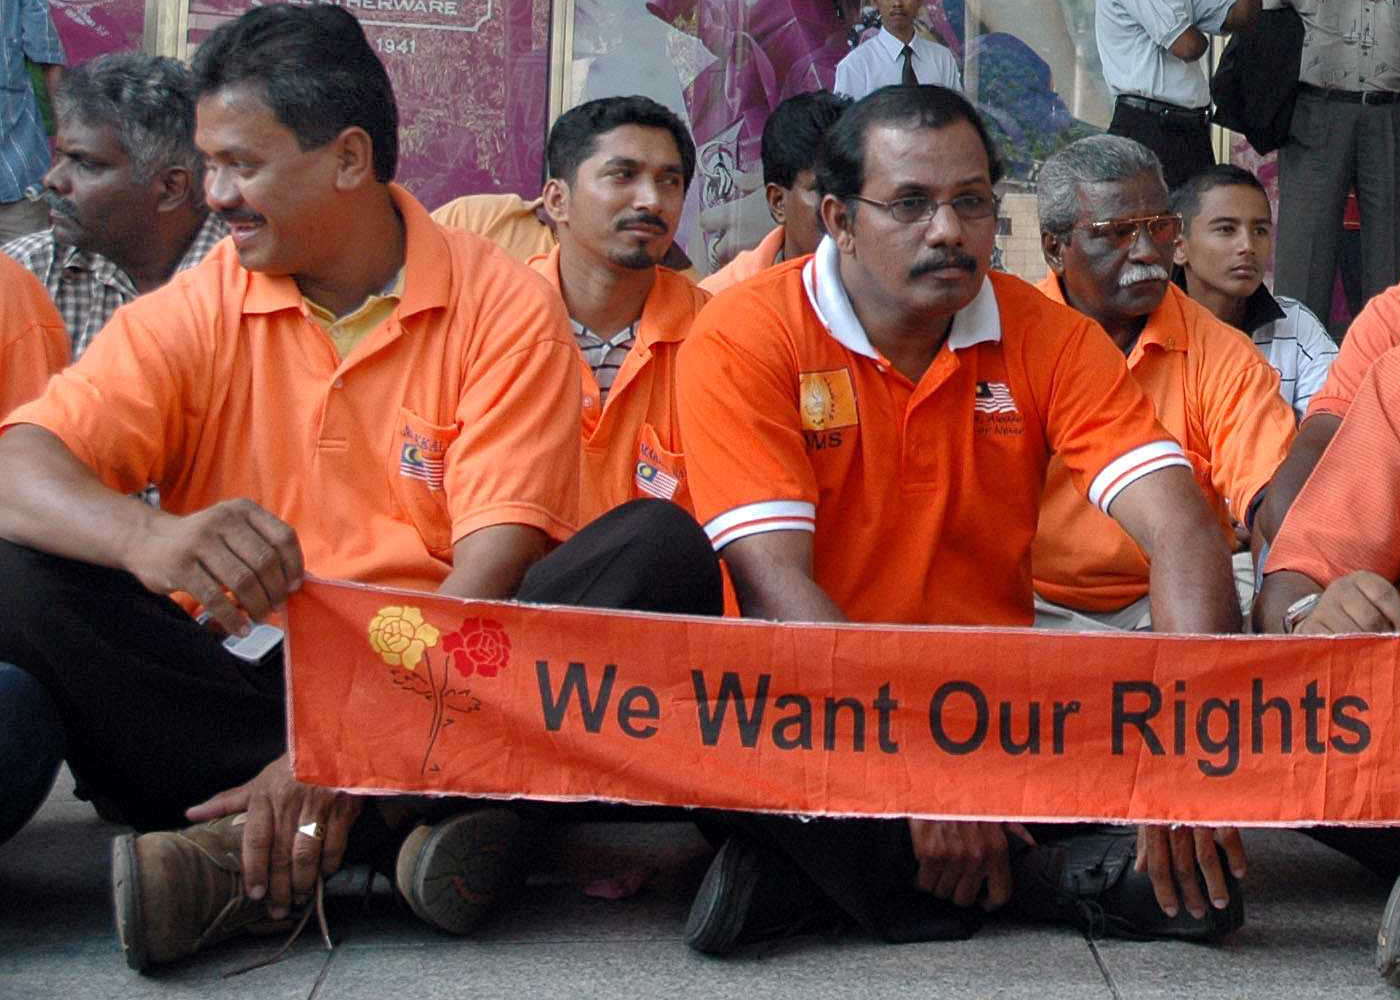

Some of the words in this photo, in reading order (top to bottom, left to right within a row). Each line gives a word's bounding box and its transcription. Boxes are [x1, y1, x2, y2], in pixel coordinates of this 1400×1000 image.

[376, 37, 416, 54] 1941
[535, 659, 661, 739] We
[691, 668, 899, 754] Want
[928, 679, 1081, 756] Our
[1110, 677, 1372, 778] Rights
